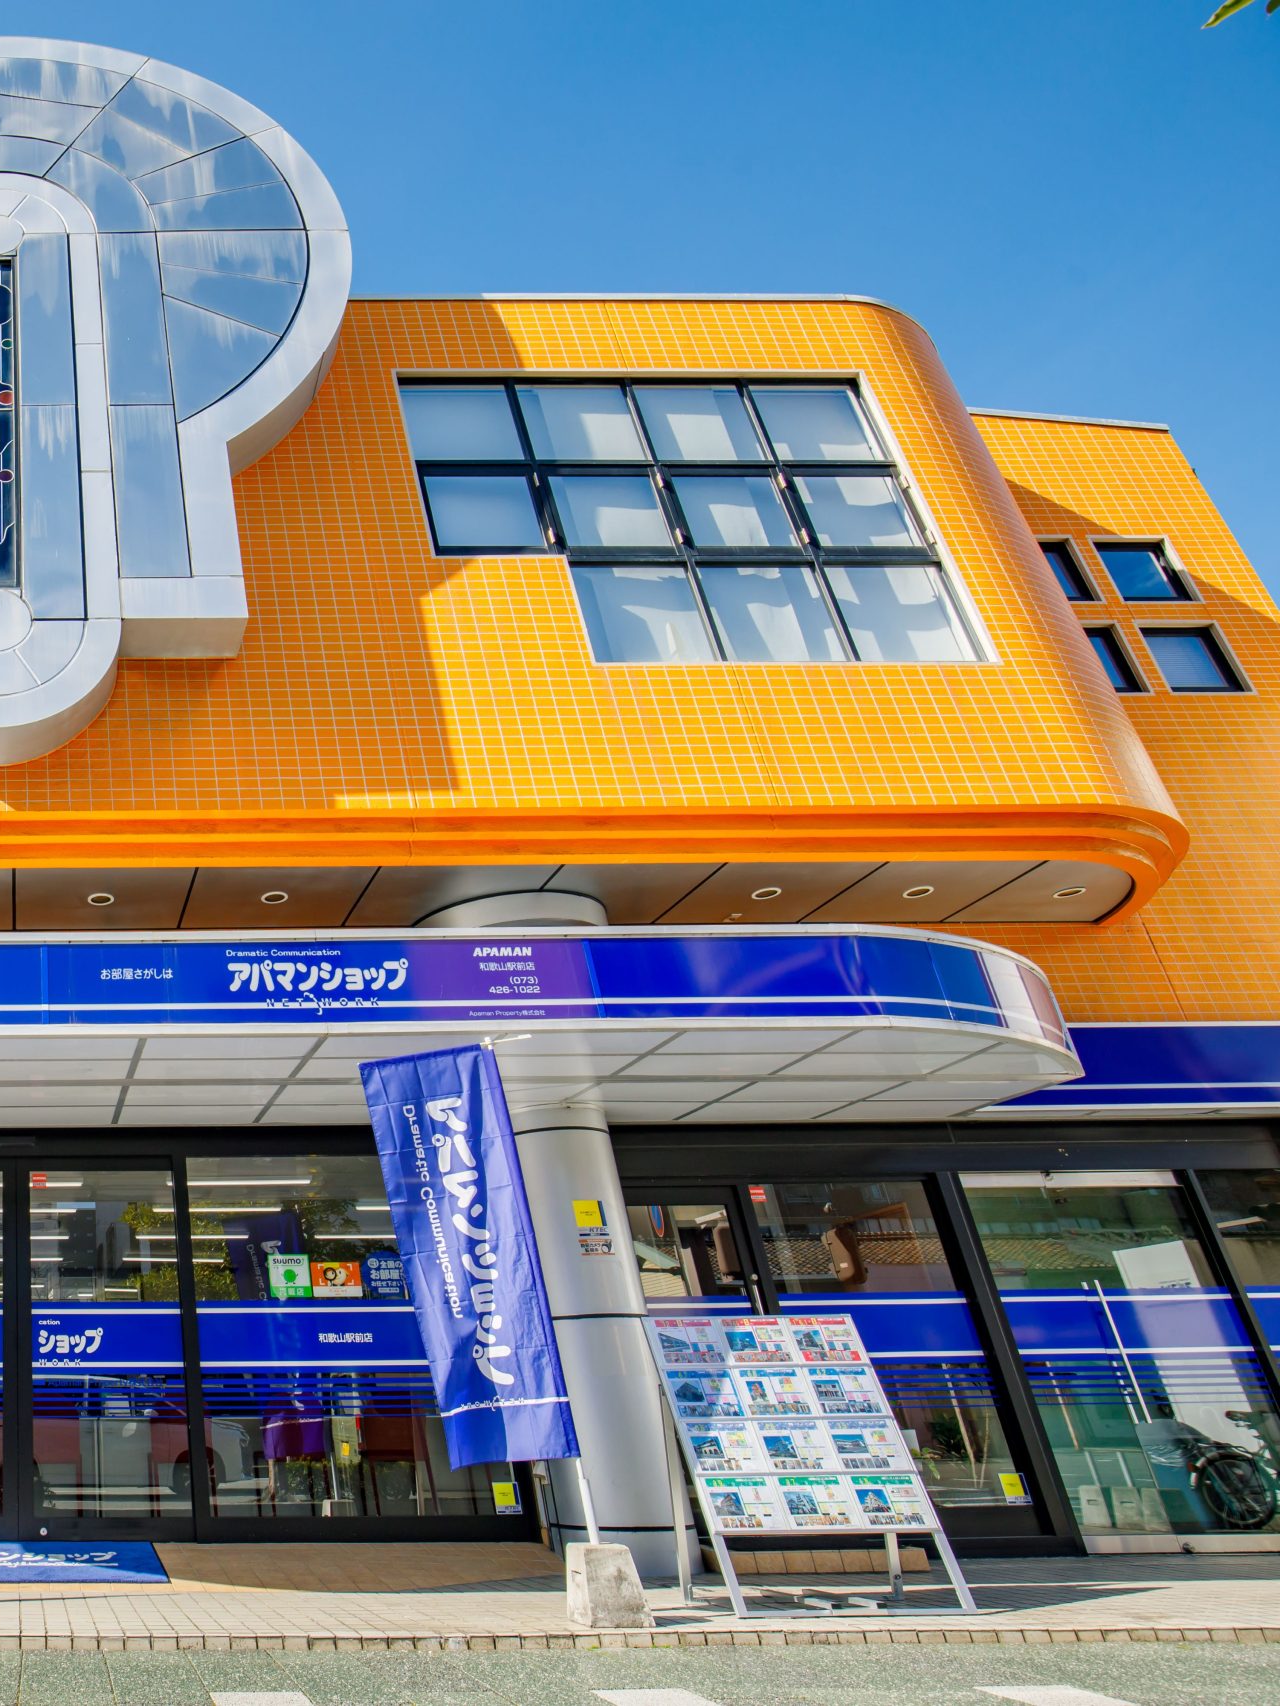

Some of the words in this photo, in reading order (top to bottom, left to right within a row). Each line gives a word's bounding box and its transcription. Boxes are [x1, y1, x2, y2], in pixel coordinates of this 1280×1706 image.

[225, 949, 269, 957] Dramatic
[270, 948, 341, 957] Communication
[472, 946, 532, 957] APAMAN
[479, 961, 536, 971] 和歌山駅前店
[100, 967, 174, 981] お部屋さがしは
[227, 957, 409, 992] アパマンショップ
[509, 976, 539, 985] (073)
[489, 985, 541, 994] 426-1022
[38, 1327, 104, 1354] ショップ
[318, 1333, 373, 1344] 和歌山駅前店
[38, 1358, 82, 1367] WORK
